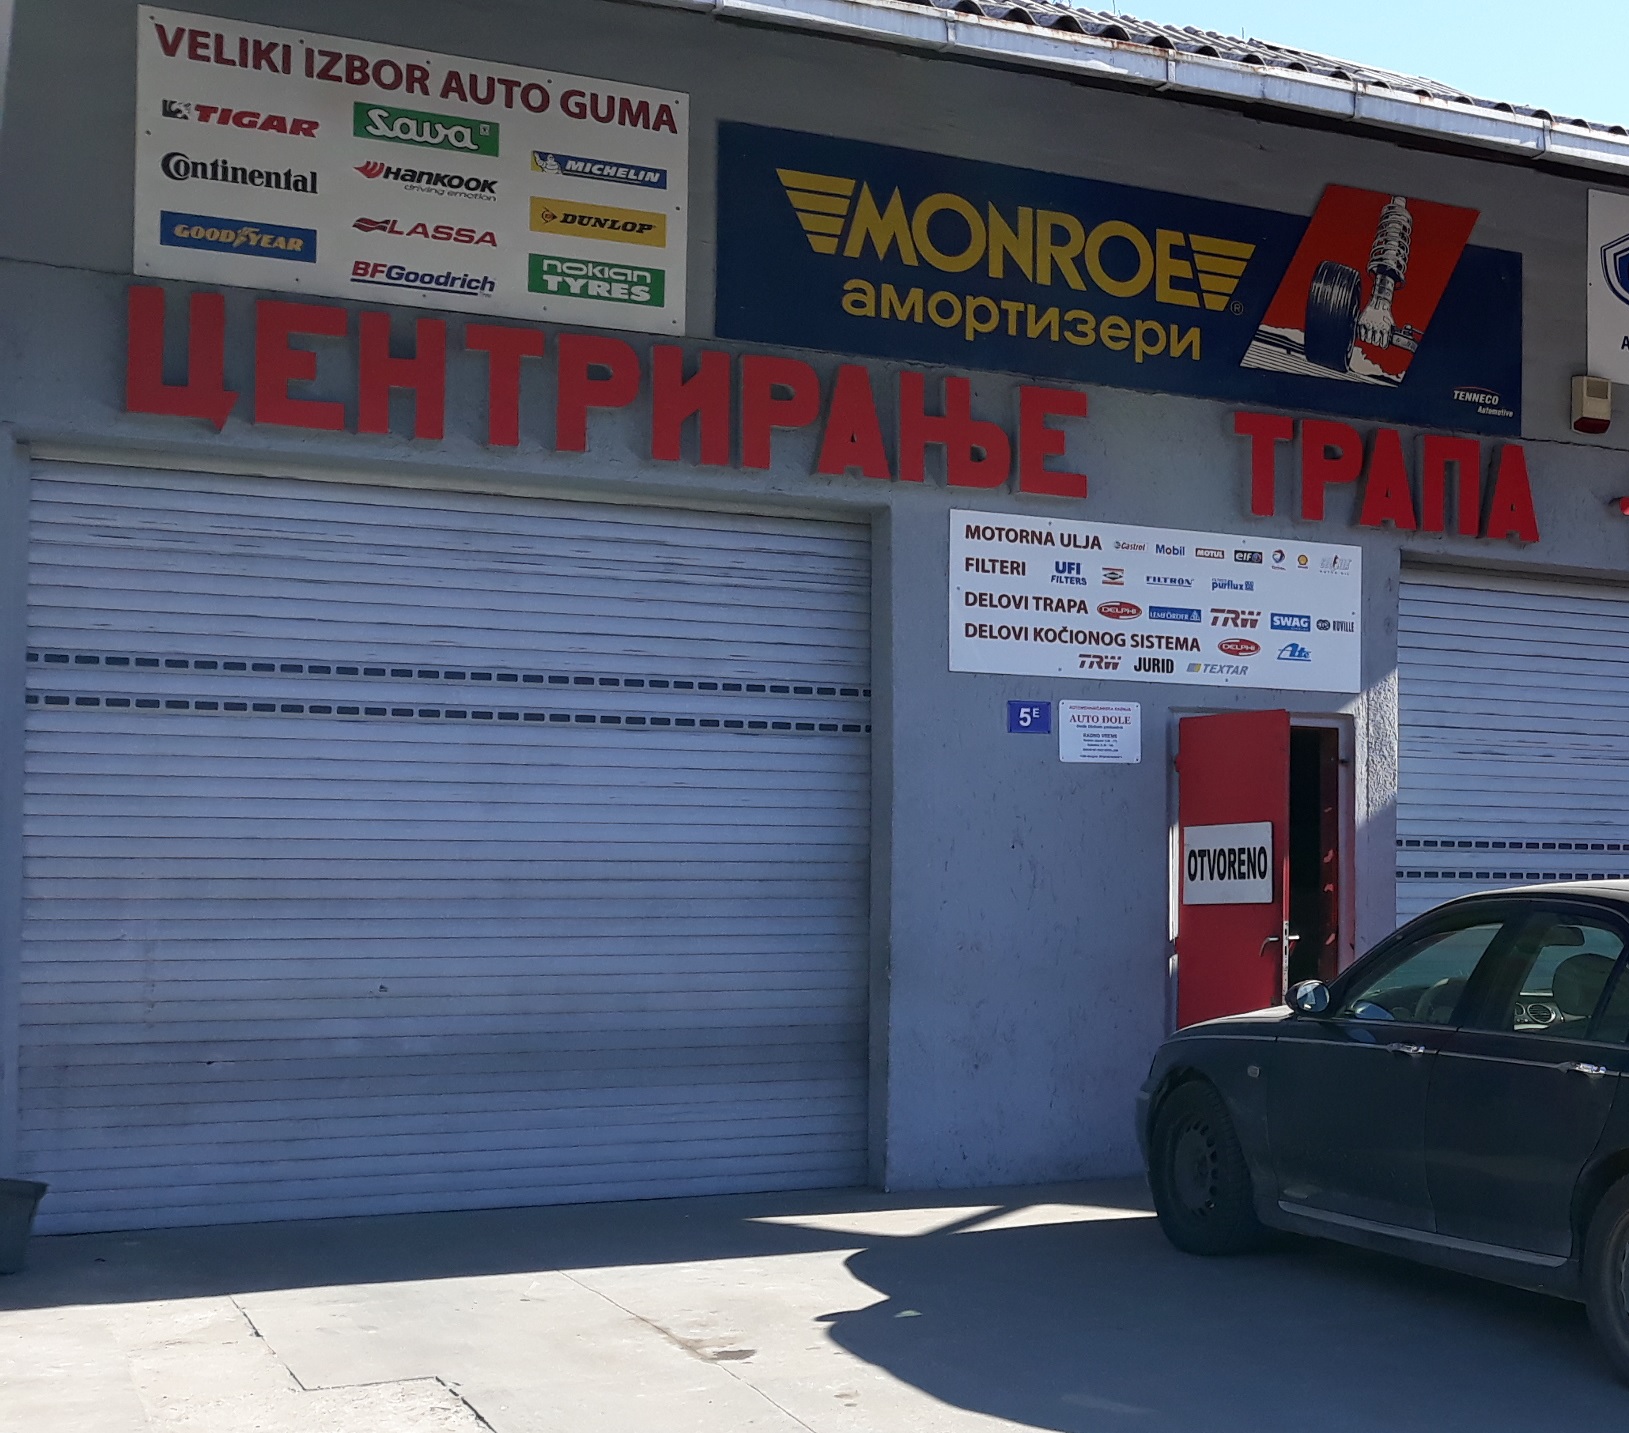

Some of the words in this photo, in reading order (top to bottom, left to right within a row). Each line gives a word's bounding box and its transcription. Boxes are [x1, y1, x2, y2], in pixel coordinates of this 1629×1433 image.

[155, 23, 291, 75] VELIKI
[304, 47, 431, 95] IZBOR
[440, 70, 551, 113] AUTO
[560, 89, 678, 134] GUMA
[195, 104, 320, 138] TIGAR
[365, 108, 479, 150] Sava
[161, 152, 318, 194] Continental
[565, 160, 661, 183] MICHELIN
[404, 184, 445, 196] driving
[447, 190, 497, 202] emotion
[560, 212, 654, 234] DUNLOP
[387, 219, 498, 247] LASSA
[844, 184, 1203, 310] MONROE
[543, 275, 651, 302] TYRES
[841, 276, 1202, 362] амортизери
[1453, 390, 1499, 405] TENNECO
[125, 286, 1088, 500] ЦЕНТРИРАЊЕ
[1233, 411, 1539, 543] ТРАПА
[1477, 405, 1513, 418] Automotive
[964, 524, 1055, 547] MOTORNA
[1060, 532, 1103, 551] ULJA
[1121, 541, 1146, 551] Castrol
[1155, 544, 1185, 556] Mobil
[1196, 550, 1224, 558] MOTUL
[964, 557, 1026, 577] FILTERI
[1055, 560, 1081, 575] UFI
[1050, 575, 1087, 586] FILTERS
[1146, 575, 1193, 586] FILTRON
[1211, 579, 1244, 592] purflux
[964, 591, 1029, 612] DELOVI
[1032, 596, 1088, 615] TRAPA
[1102, 607, 1138, 615] DELPHI
[1210, 608, 1261, 629] TRW
[1273, 616, 1309, 628] SWAG
[964, 622, 1029, 643] DELOVI
[1033, 626, 1126, 648] KOČIONOG
[1130, 635, 1200, 652] SISTEMA
[1222, 643, 1258, 652] DELPHI
[1078, 653, 1122, 671] TRW
[1133, 656, 1174, 674] JURID
[1203, 663, 1249, 676] TEXTAR
[1070, 714, 1099, 724] AUTO
[1187, 846, 1268, 881] OTVORENO
